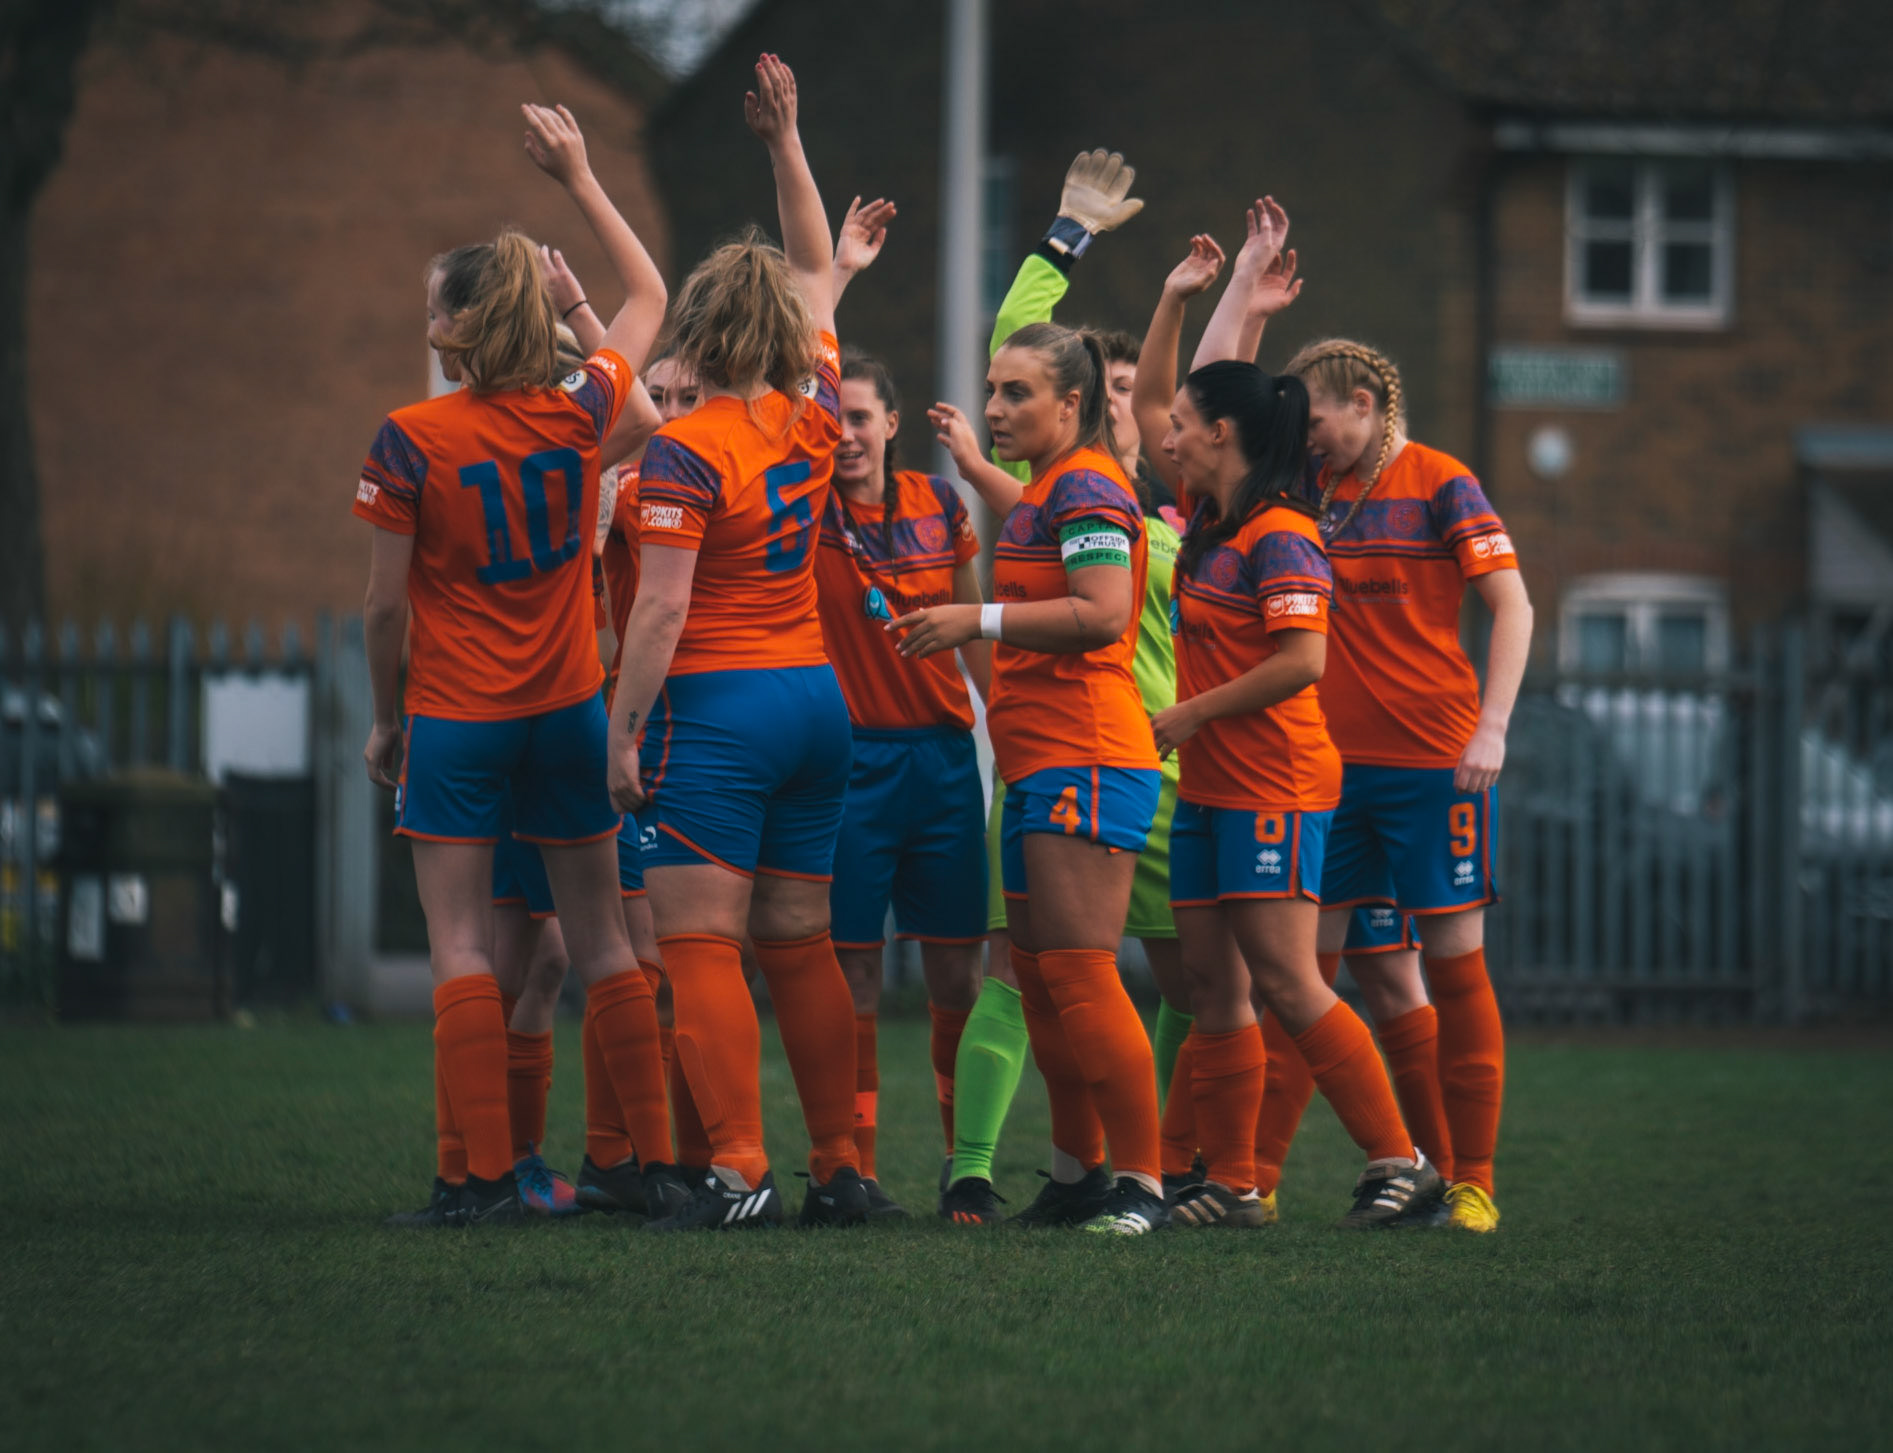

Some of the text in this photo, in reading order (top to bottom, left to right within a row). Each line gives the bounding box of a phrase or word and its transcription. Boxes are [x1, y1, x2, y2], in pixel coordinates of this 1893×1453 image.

[458, 446, 583, 585] 10
[650, 505, 683, 519] 99KITS
[1067, 519, 1122, 536] CAPTA
[1091, 535, 1126, 546] OFFSIDE
[1093, 540, 1121, 549] TRUST
[1069, 551, 1128, 566] RESPECT
[1048, 786, 1081, 835] 4
[1448, 802, 1478, 857] 9
